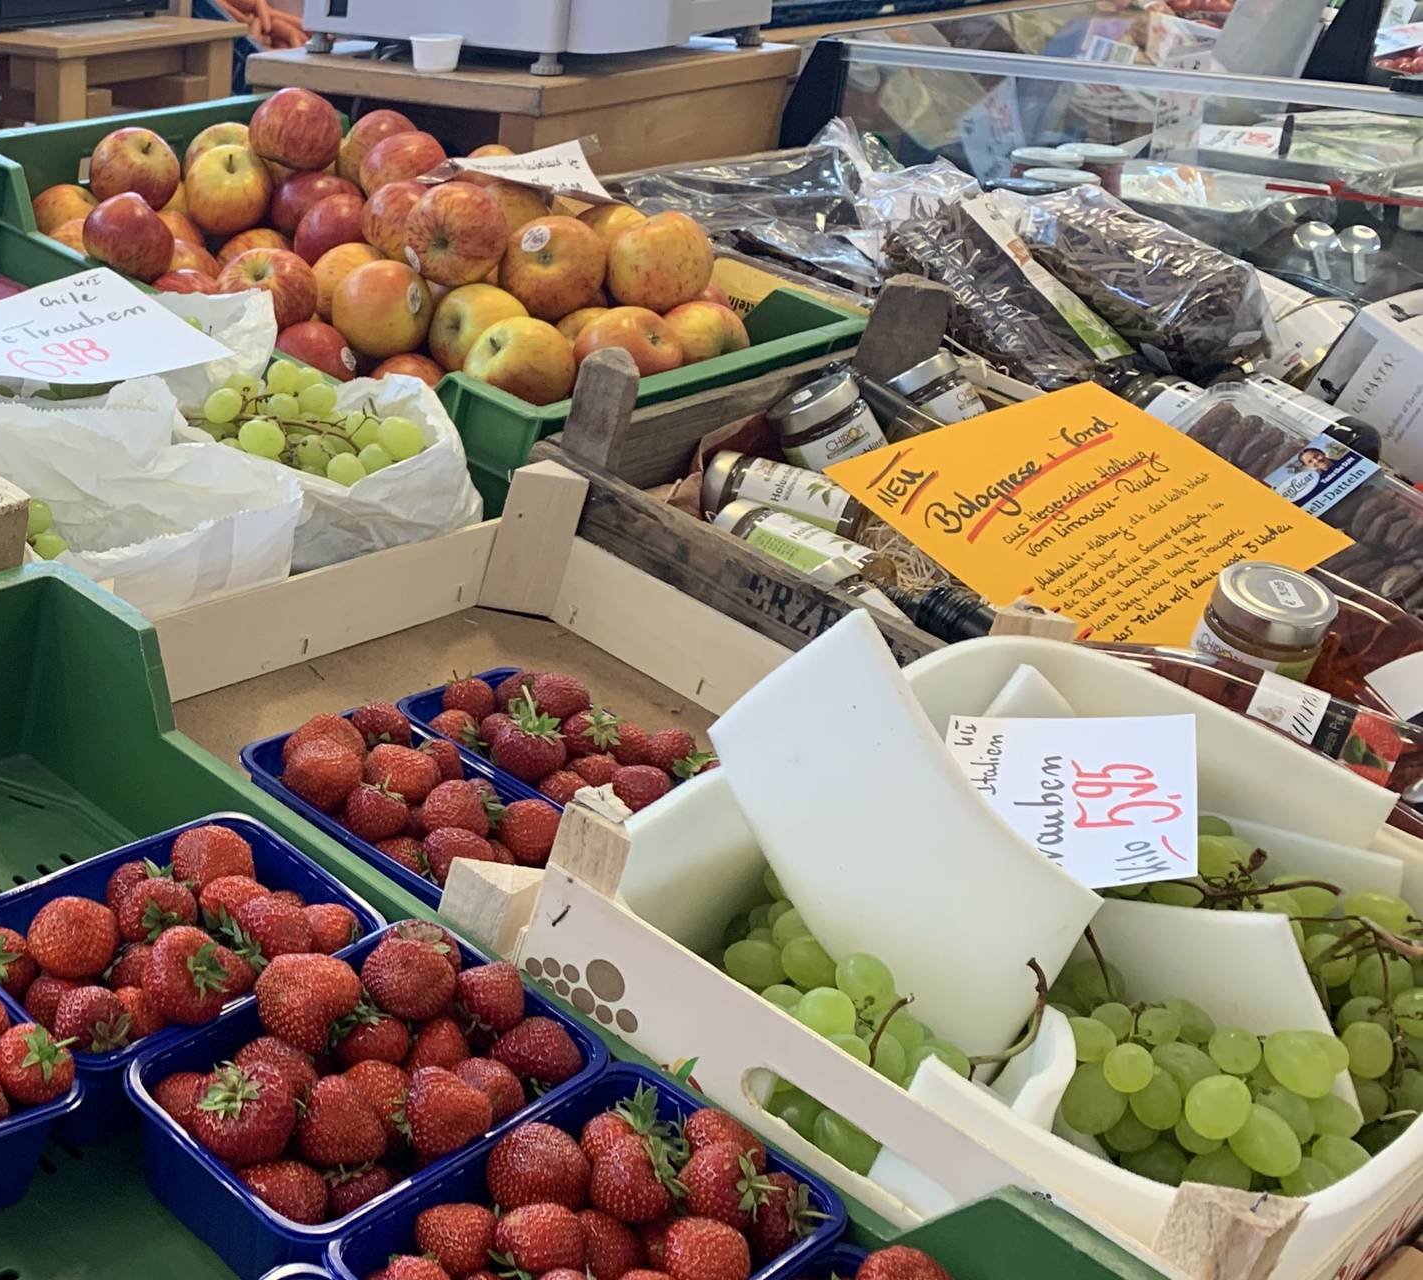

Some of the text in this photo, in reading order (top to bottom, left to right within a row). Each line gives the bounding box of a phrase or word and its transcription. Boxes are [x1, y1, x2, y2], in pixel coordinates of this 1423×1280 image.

[39, 292, 97, 307] Chile
[3, 305, 146, 339] Trauben
[876, 468, 924, 508] NEU
[925, 459, 1042, 533] Bolognese
[1003, 523, 1030, 544] aus
[970, 734, 1005, 796] Italien
[1013, 755, 1065, 867] rauben
[1115, 840, 1172, 882] Kilo
